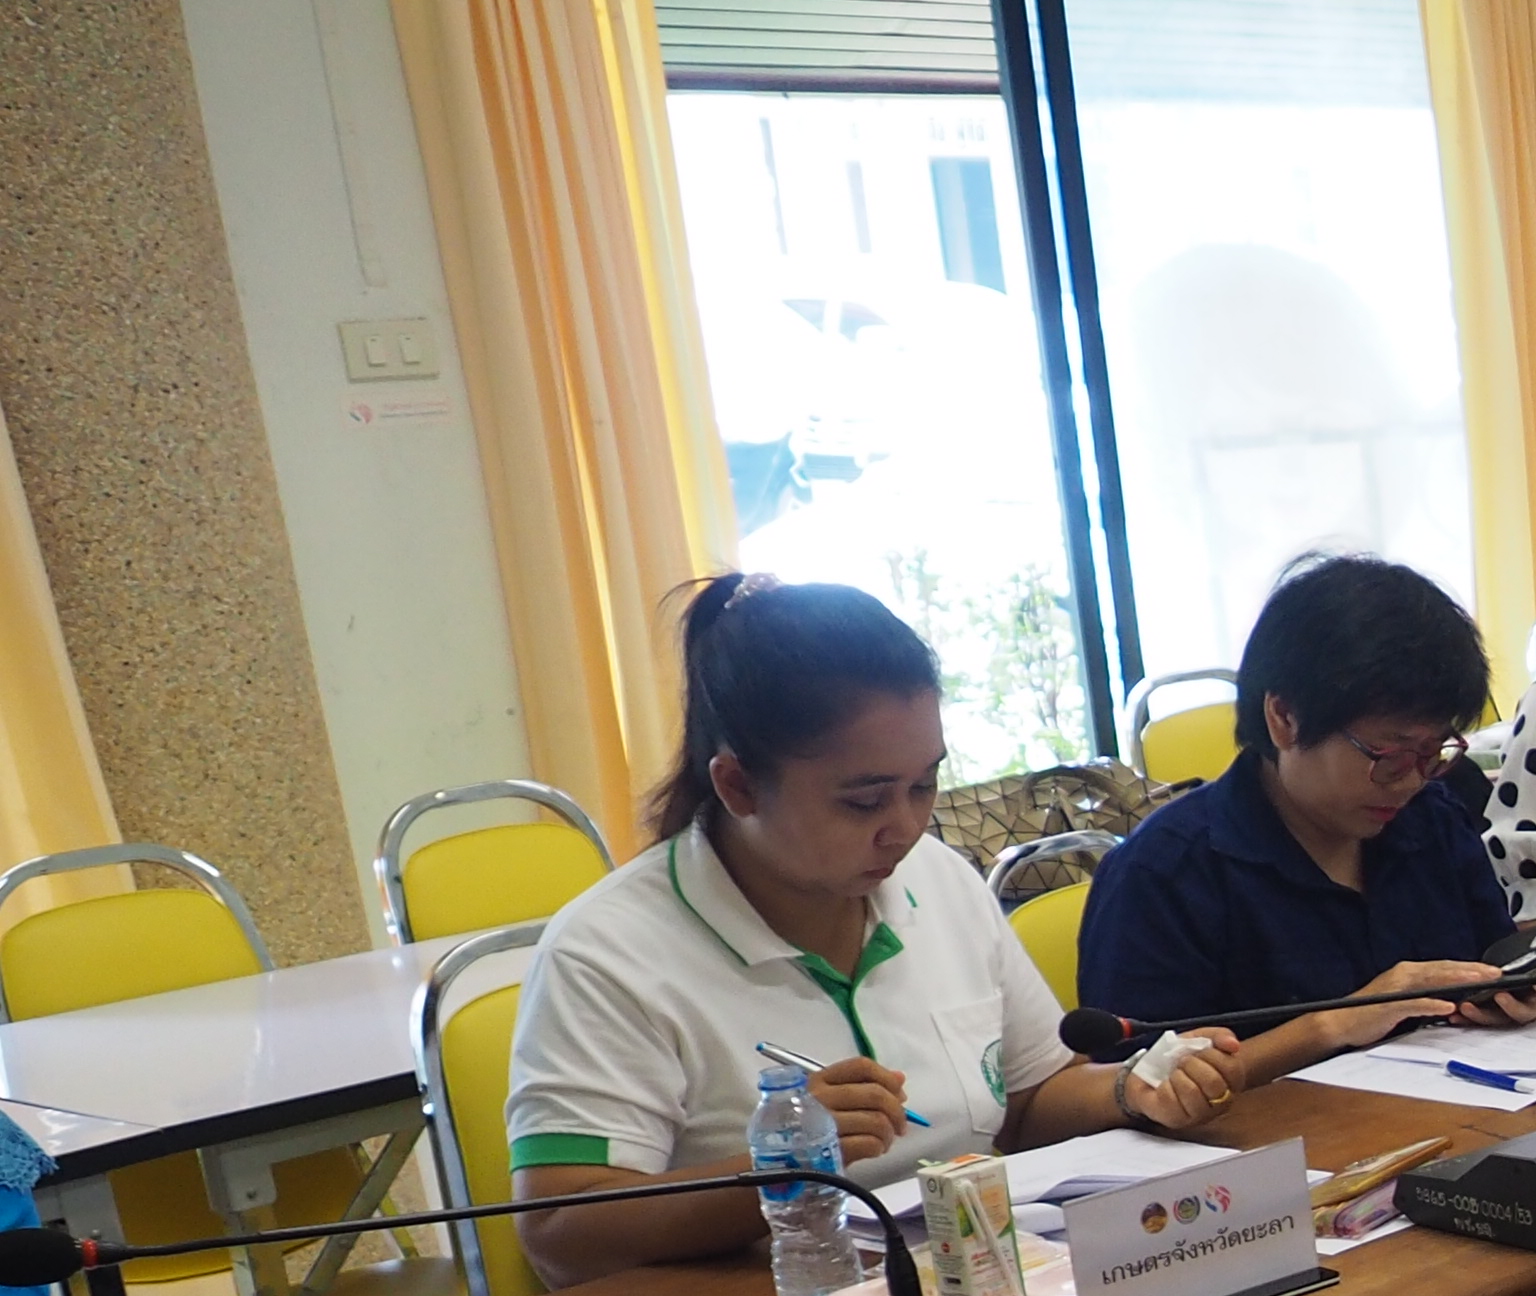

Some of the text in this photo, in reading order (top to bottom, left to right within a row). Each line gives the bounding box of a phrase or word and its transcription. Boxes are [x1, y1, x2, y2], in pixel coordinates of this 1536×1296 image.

[1101, 1214, 1295, 1285] เกษตรจังหวัดยะลา
